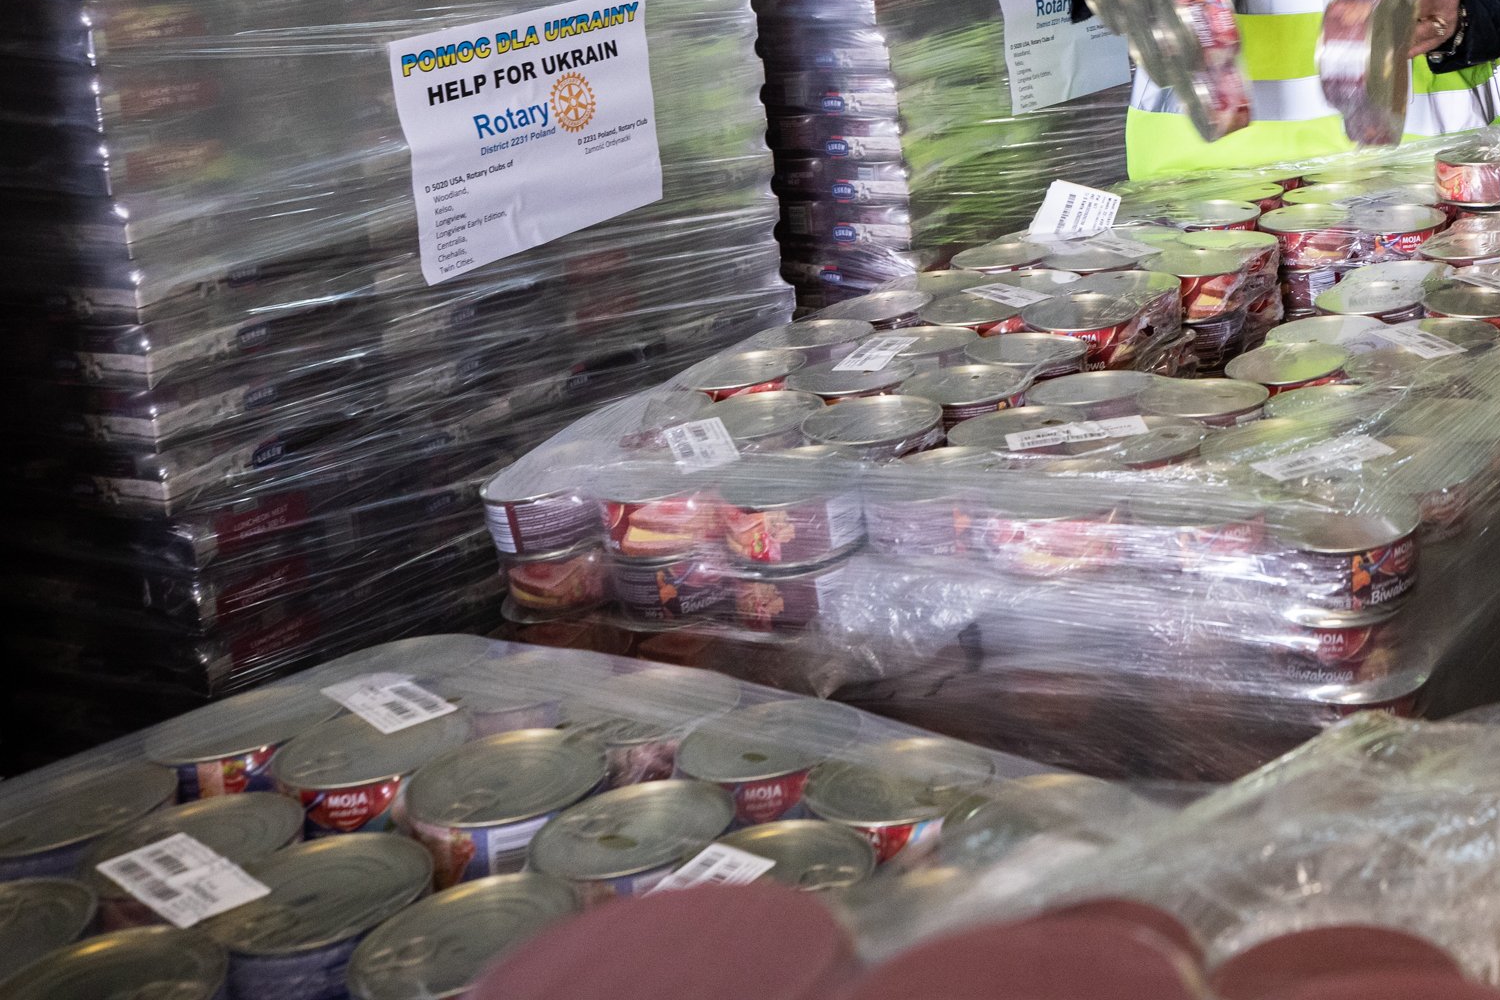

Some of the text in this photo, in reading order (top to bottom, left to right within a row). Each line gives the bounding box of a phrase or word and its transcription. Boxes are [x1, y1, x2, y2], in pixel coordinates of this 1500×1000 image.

[401, 1, 639, 77] POMOC DLA UKRAINY
[427, 39, 619, 106] HELP FOR UKRAIN
[473, 102, 549, 139] Rotary
[577, 118, 648, 146] D 2231 Poland, Rotary Club
[480, 126, 556, 157] District 2231 Poland
[425, 159, 514, 193] D 5020 USA, Rotary Clubs of
[433, 188, 469, 203] Woodland,
[434, 204, 454, 216] Kelso,
[435, 213, 467, 228] Longview,
[435, 210, 507, 240] Longview Early Edition,
[436, 236, 468, 252] Centralia,
[1402, 235, 1421, 244] MOJA
[438, 247, 467, 263] Chehalis,
[439, 257, 475, 275] Twin Cities.
[327, 791, 368, 809] MOJA
[744, 784, 782, 800] MOJA
